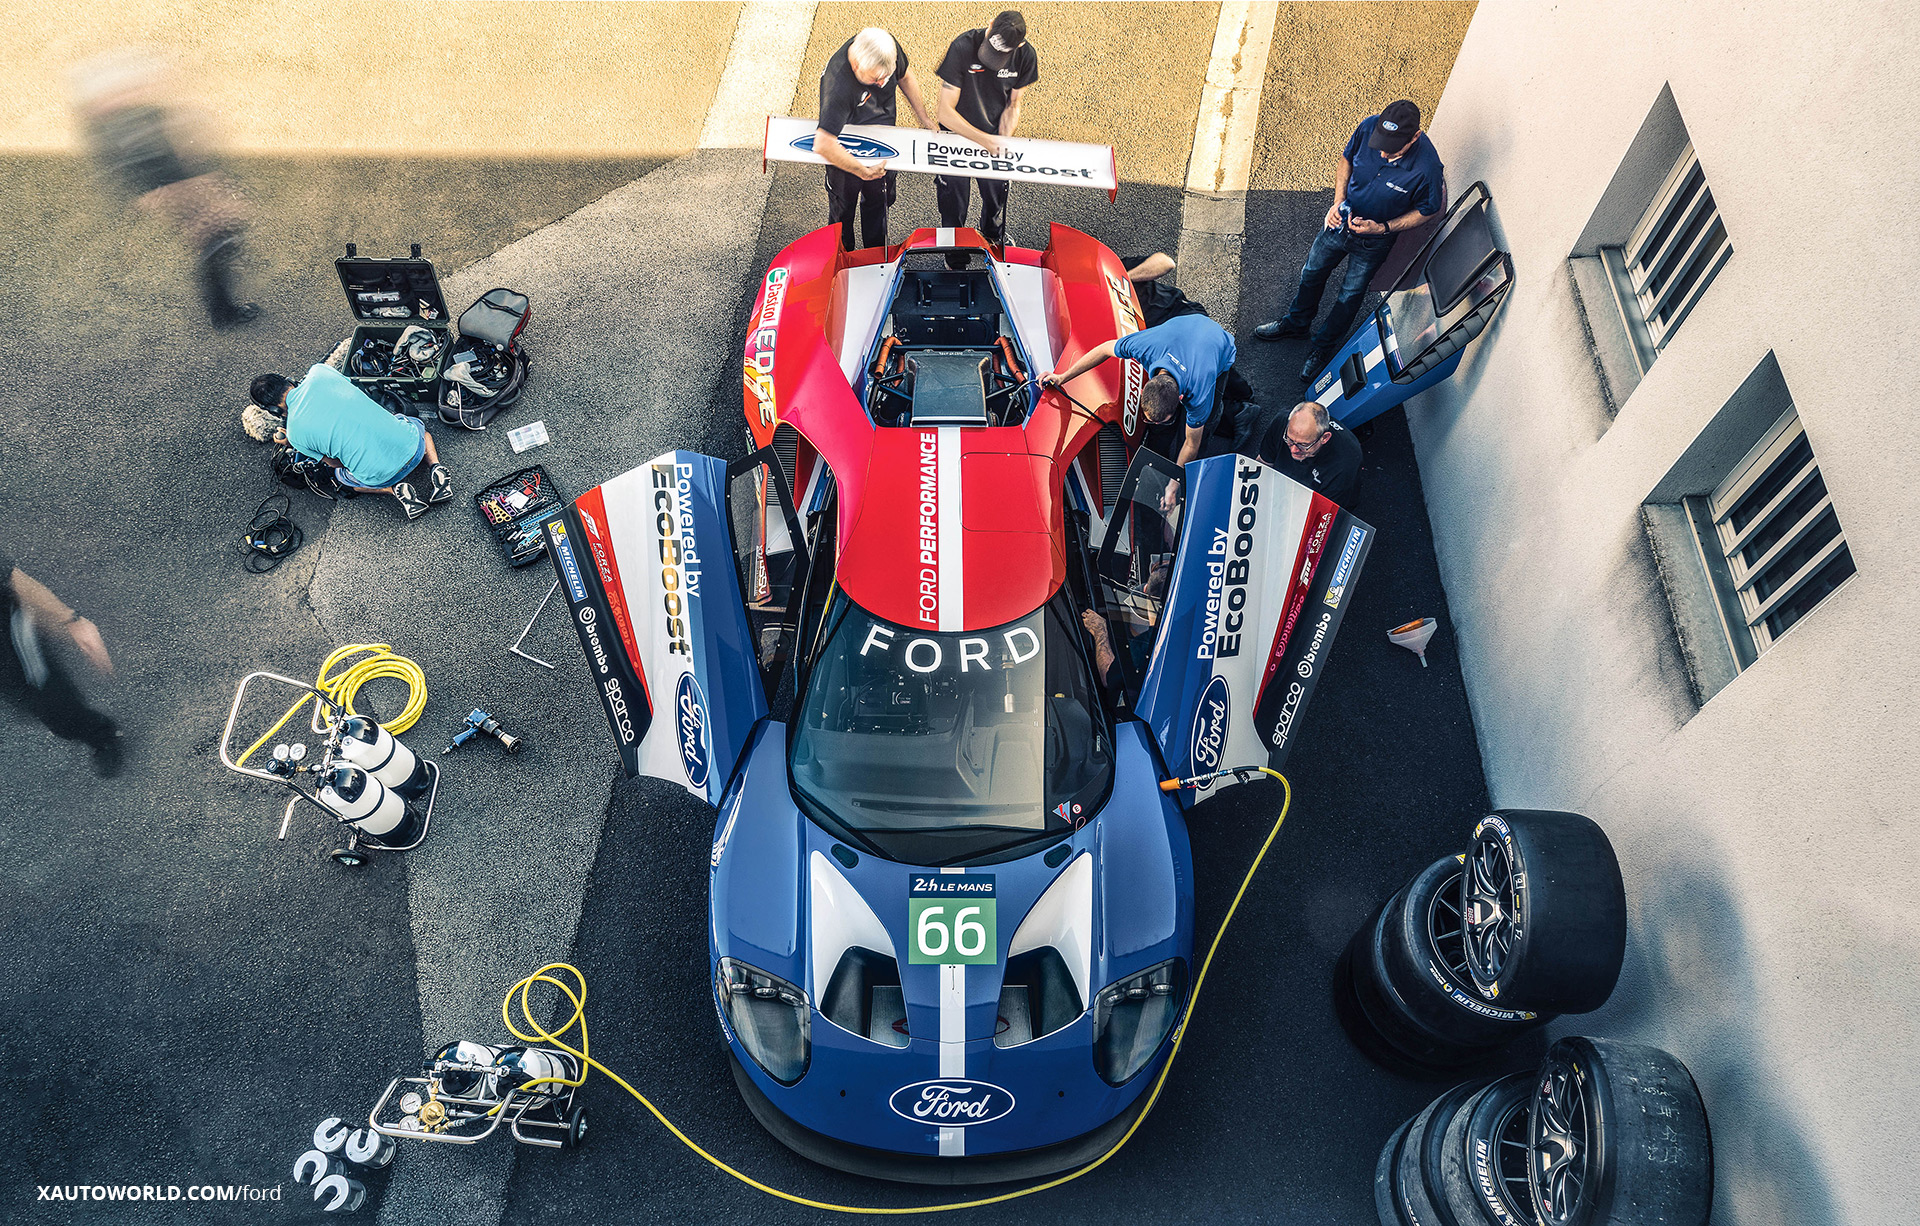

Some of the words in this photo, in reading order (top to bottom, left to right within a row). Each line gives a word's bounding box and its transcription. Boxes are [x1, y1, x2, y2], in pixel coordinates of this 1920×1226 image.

[927, 142, 1001, 159] Powered
[1005, 148, 1024, 162] by
[927, 154, 1094, 180] EcoBoost
[761, 283, 783, 325] Castrol
[755, 329, 778, 429] EDGE
[676, 462, 702, 564] Powered
[919, 432, 937, 566] PERFORMANCE
[1207, 527, 1229, 556] by
[1310, 512, 1329, 554] FORZA
[1315, 513, 1333, 554] MOTORSPORT
[1336, 529, 1361, 584] MICHELIN
[561, 545, 584, 599] MICHELIN
[595, 543, 613, 583] FORZA
[651, 464, 690, 656] EcoBoost
[685, 570, 703, 598] by
[1216, 465, 1262, 659] EcoBoost
[919, 567, 937, 624] FORD
[1197, 561, 1224, 660] Powered
[585, 622, 609, 674] brembo
[859, 624, 1041, 673] FORD
[1304, 612, 1332, 664] brembo
[603, 678, 635, 745] sparco
[680, 695, 707, 767] Ford
[1195, 700, 1226, 767] Ford
[1272, 682, 1305, 749] sparco
[940, 883, 956, 892] LE
[957, 883, 993, 892] MANS
[917, 906, 987, 956] 66
[1453, 993, 1516, 1019] MICHELIN
[913, 1085, 992, 1118] Ford
[1476, 1139, 1506, 1217] MICHELIN
